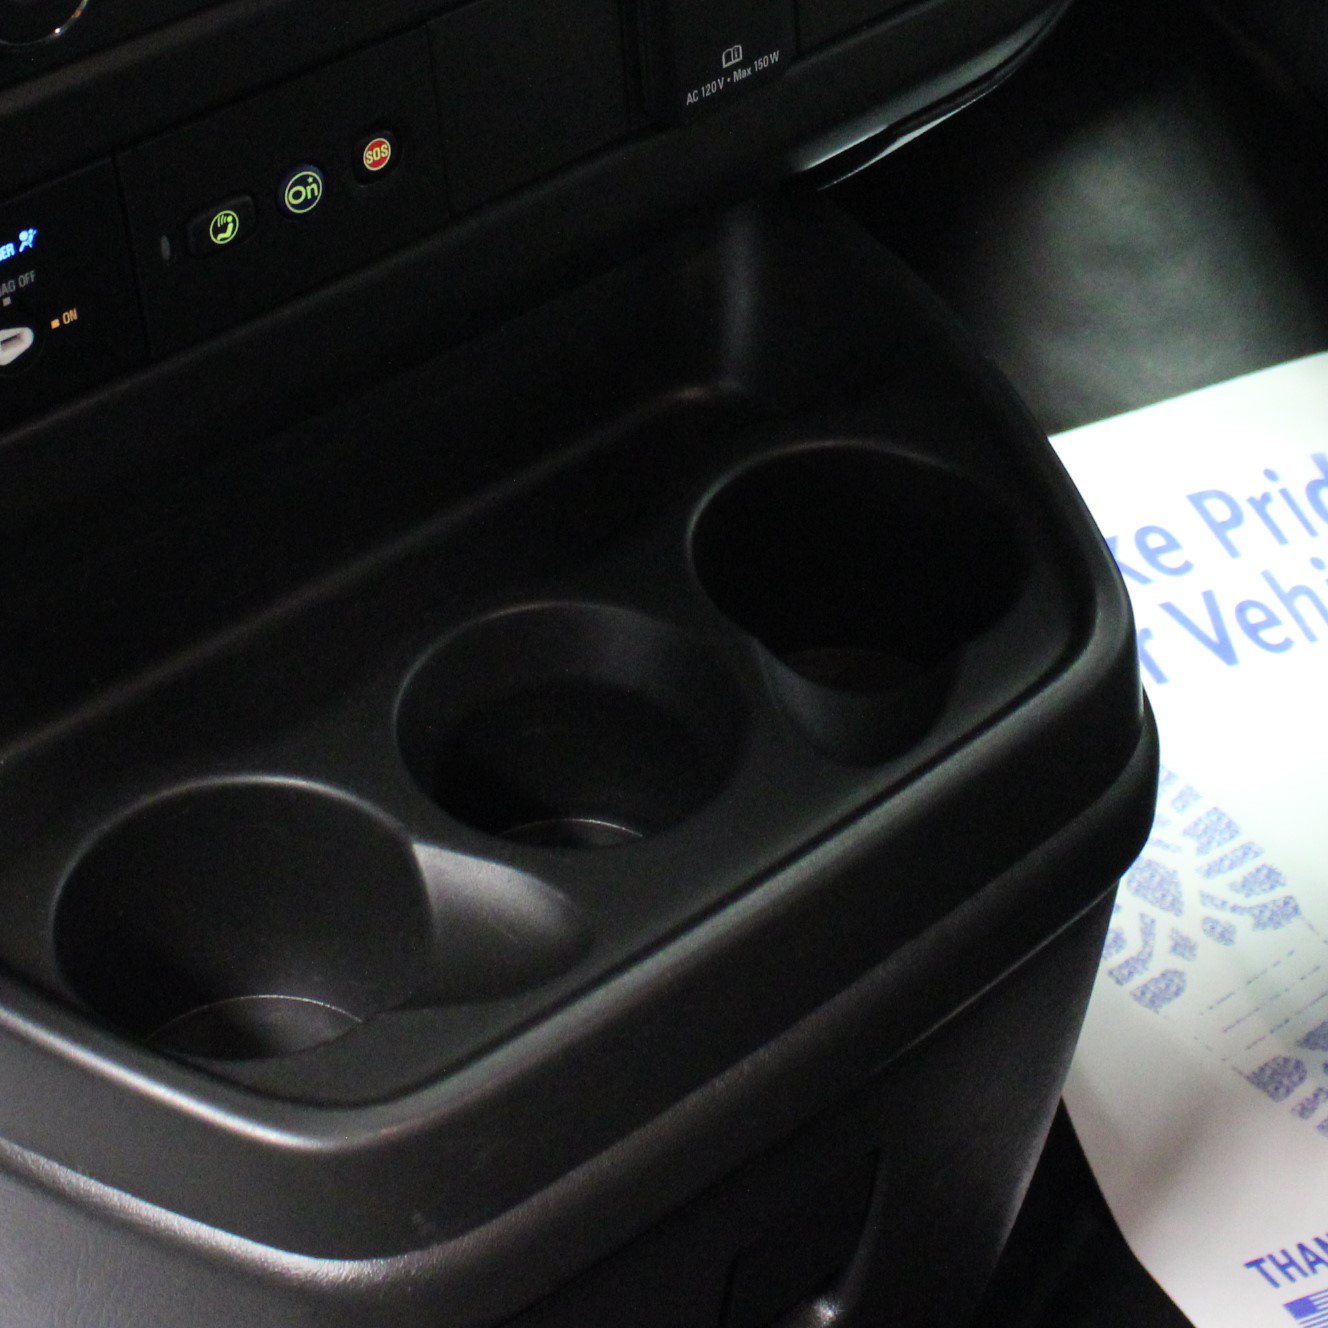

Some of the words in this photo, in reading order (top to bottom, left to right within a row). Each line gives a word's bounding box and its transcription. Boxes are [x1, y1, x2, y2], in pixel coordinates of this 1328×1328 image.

[686, 90, 699, 106] AC
[733, 67, 752, 83] Max
[366, 144, 388, 165] SOS
[18, 270, 36, 288] OFF
[62, 308, 78, 325] ON
